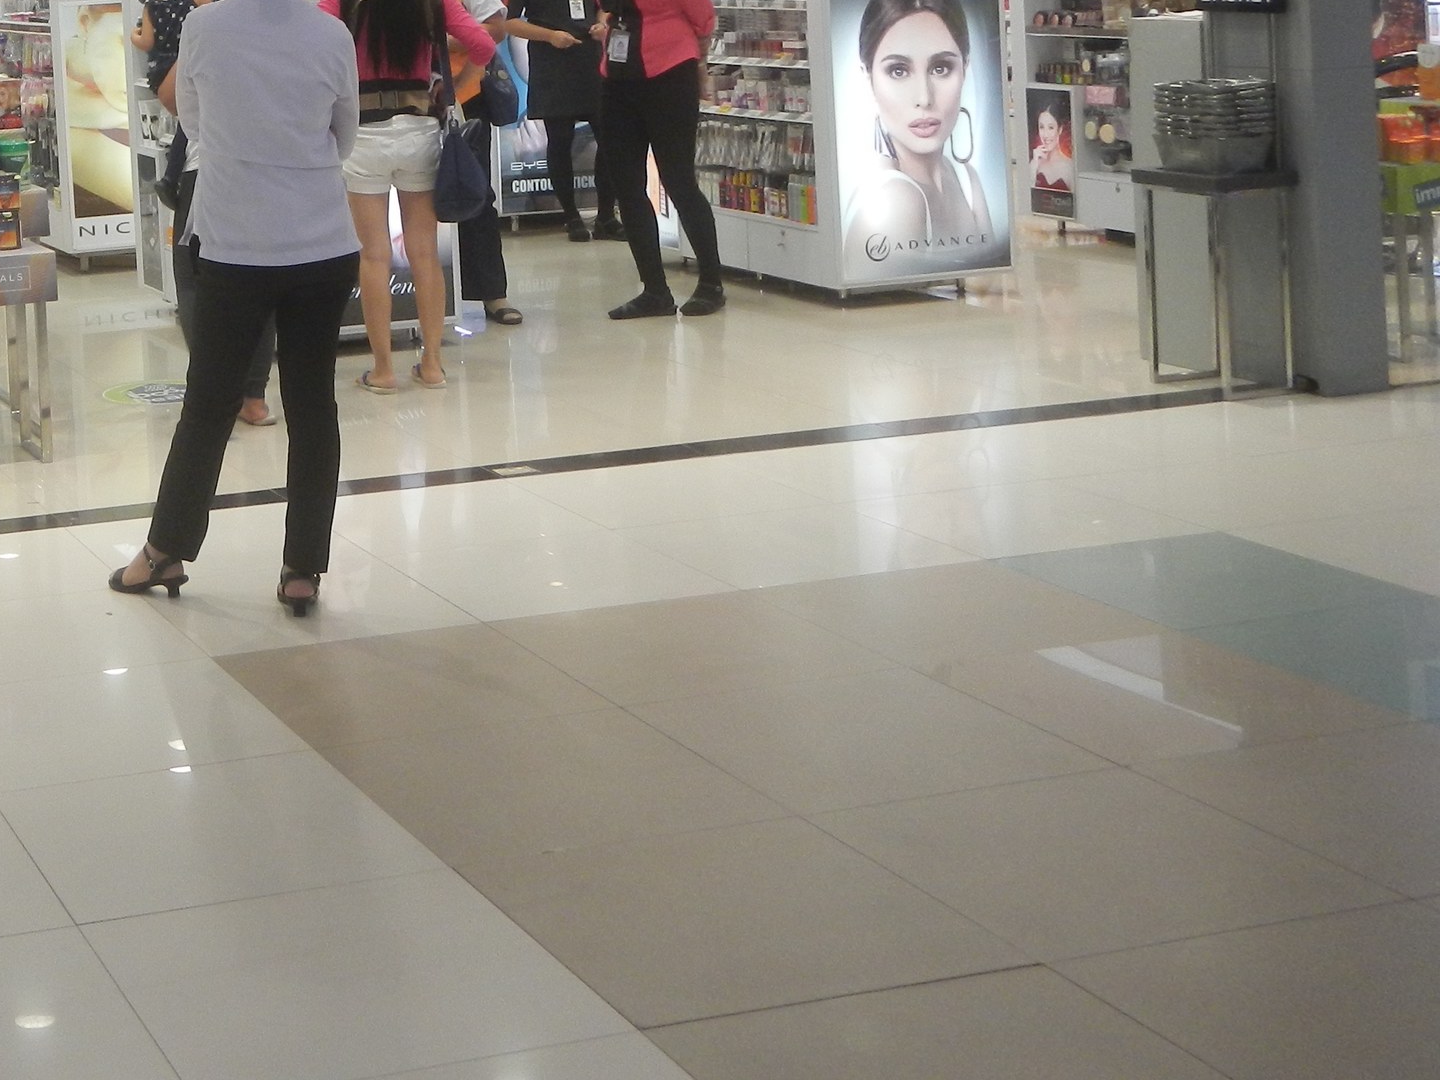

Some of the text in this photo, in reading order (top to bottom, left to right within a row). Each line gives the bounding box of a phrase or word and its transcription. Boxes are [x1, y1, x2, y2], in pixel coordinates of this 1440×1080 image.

[512, 174, 597, 194] CONTOU TICK
[78, 221, 131, 238] NIC
[895, 233, 989, 251] ADVANCE
